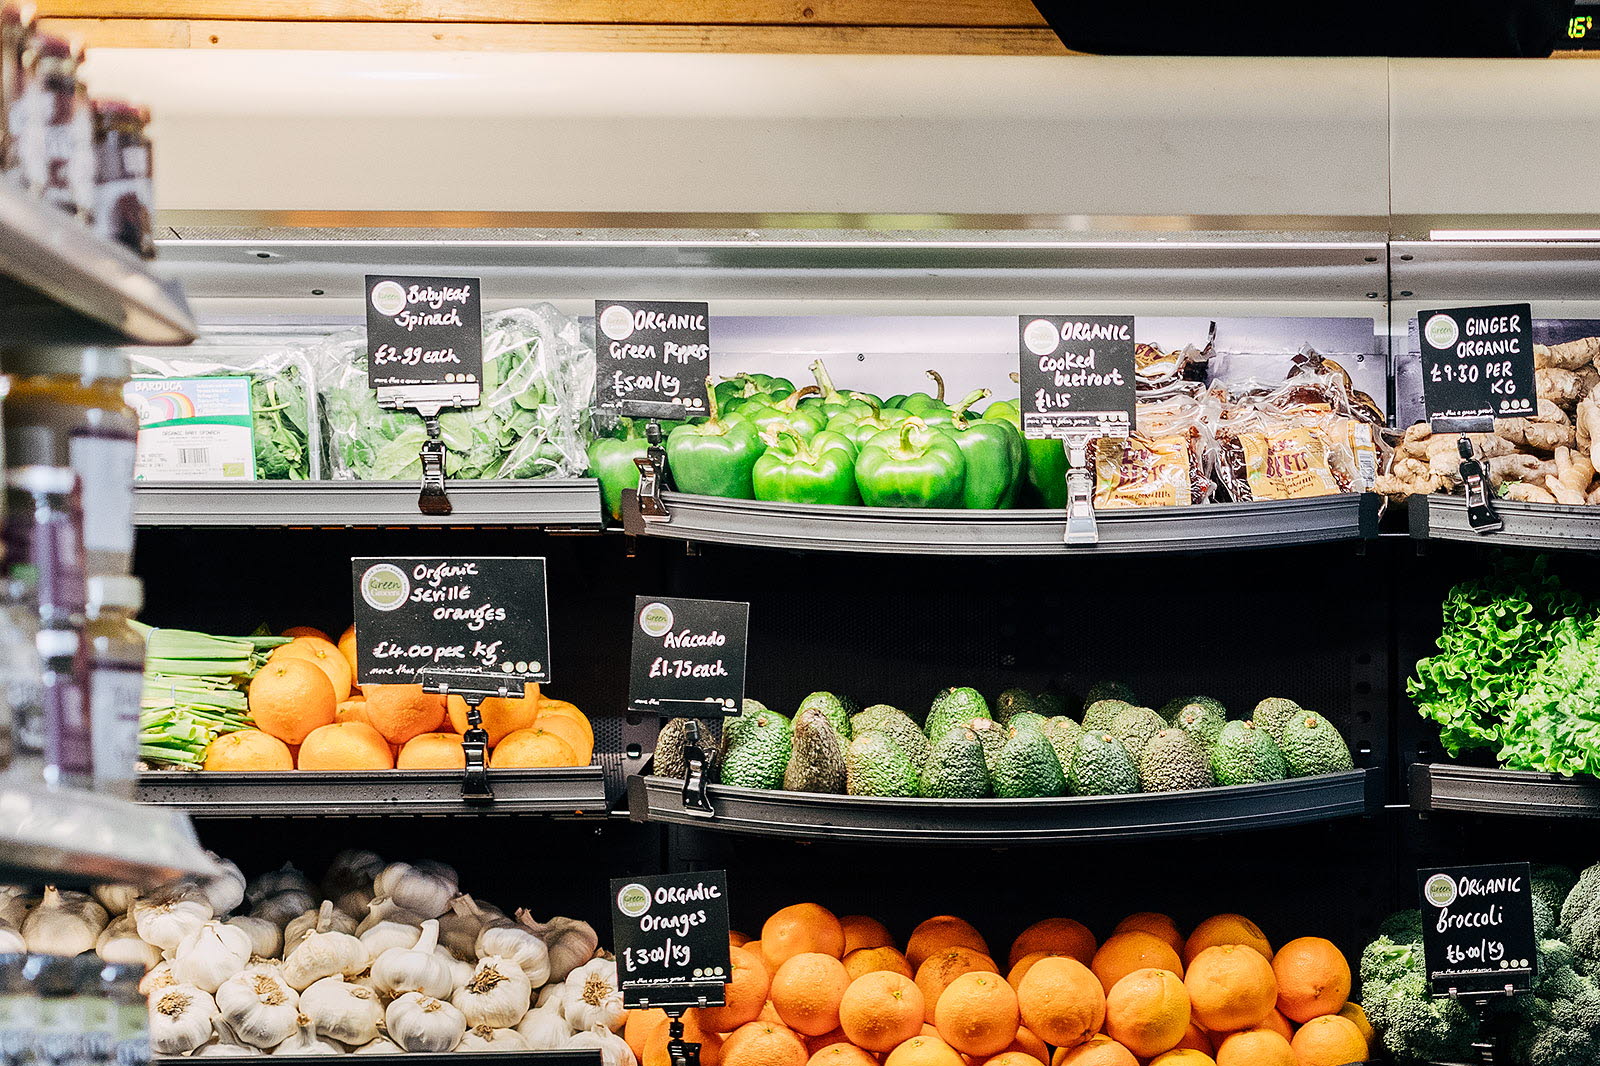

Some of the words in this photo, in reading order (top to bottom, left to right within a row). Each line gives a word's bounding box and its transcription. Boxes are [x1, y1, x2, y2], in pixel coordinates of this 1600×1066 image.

[407, 284, 471, 309] Babyleaf
[394, 308, 463, 331] Spinach
[634, 310, 706, 333] ORGANIC
[1061, 321, 1131, 341] ORGANIC
[1465, 314, 1522, 336] GINGER
[609, 341, 657, 361] Green
[1039, 348, 1096, 372] Cooked
[1456, 338, 1520, 359] ORGANIC
[1054, 367, 1125, 387] beetroot
[1485, 360, 1513, 378] PER
[1491, 378, 1517, 394] KG
[1034, 388, 1072, 413] £1.15
[413, 561, 479, 587] Organic
[372, 641, 434, 660] £4.00
[648, 656, 694, 679] £1.75
[654, 882, 722, 905] ORGANIC
[1458, 876, 1521, 897] ORGANIC
[640, 909, 707, 938] Oranges
[1436, 904, 1503, 934] Broccoli
